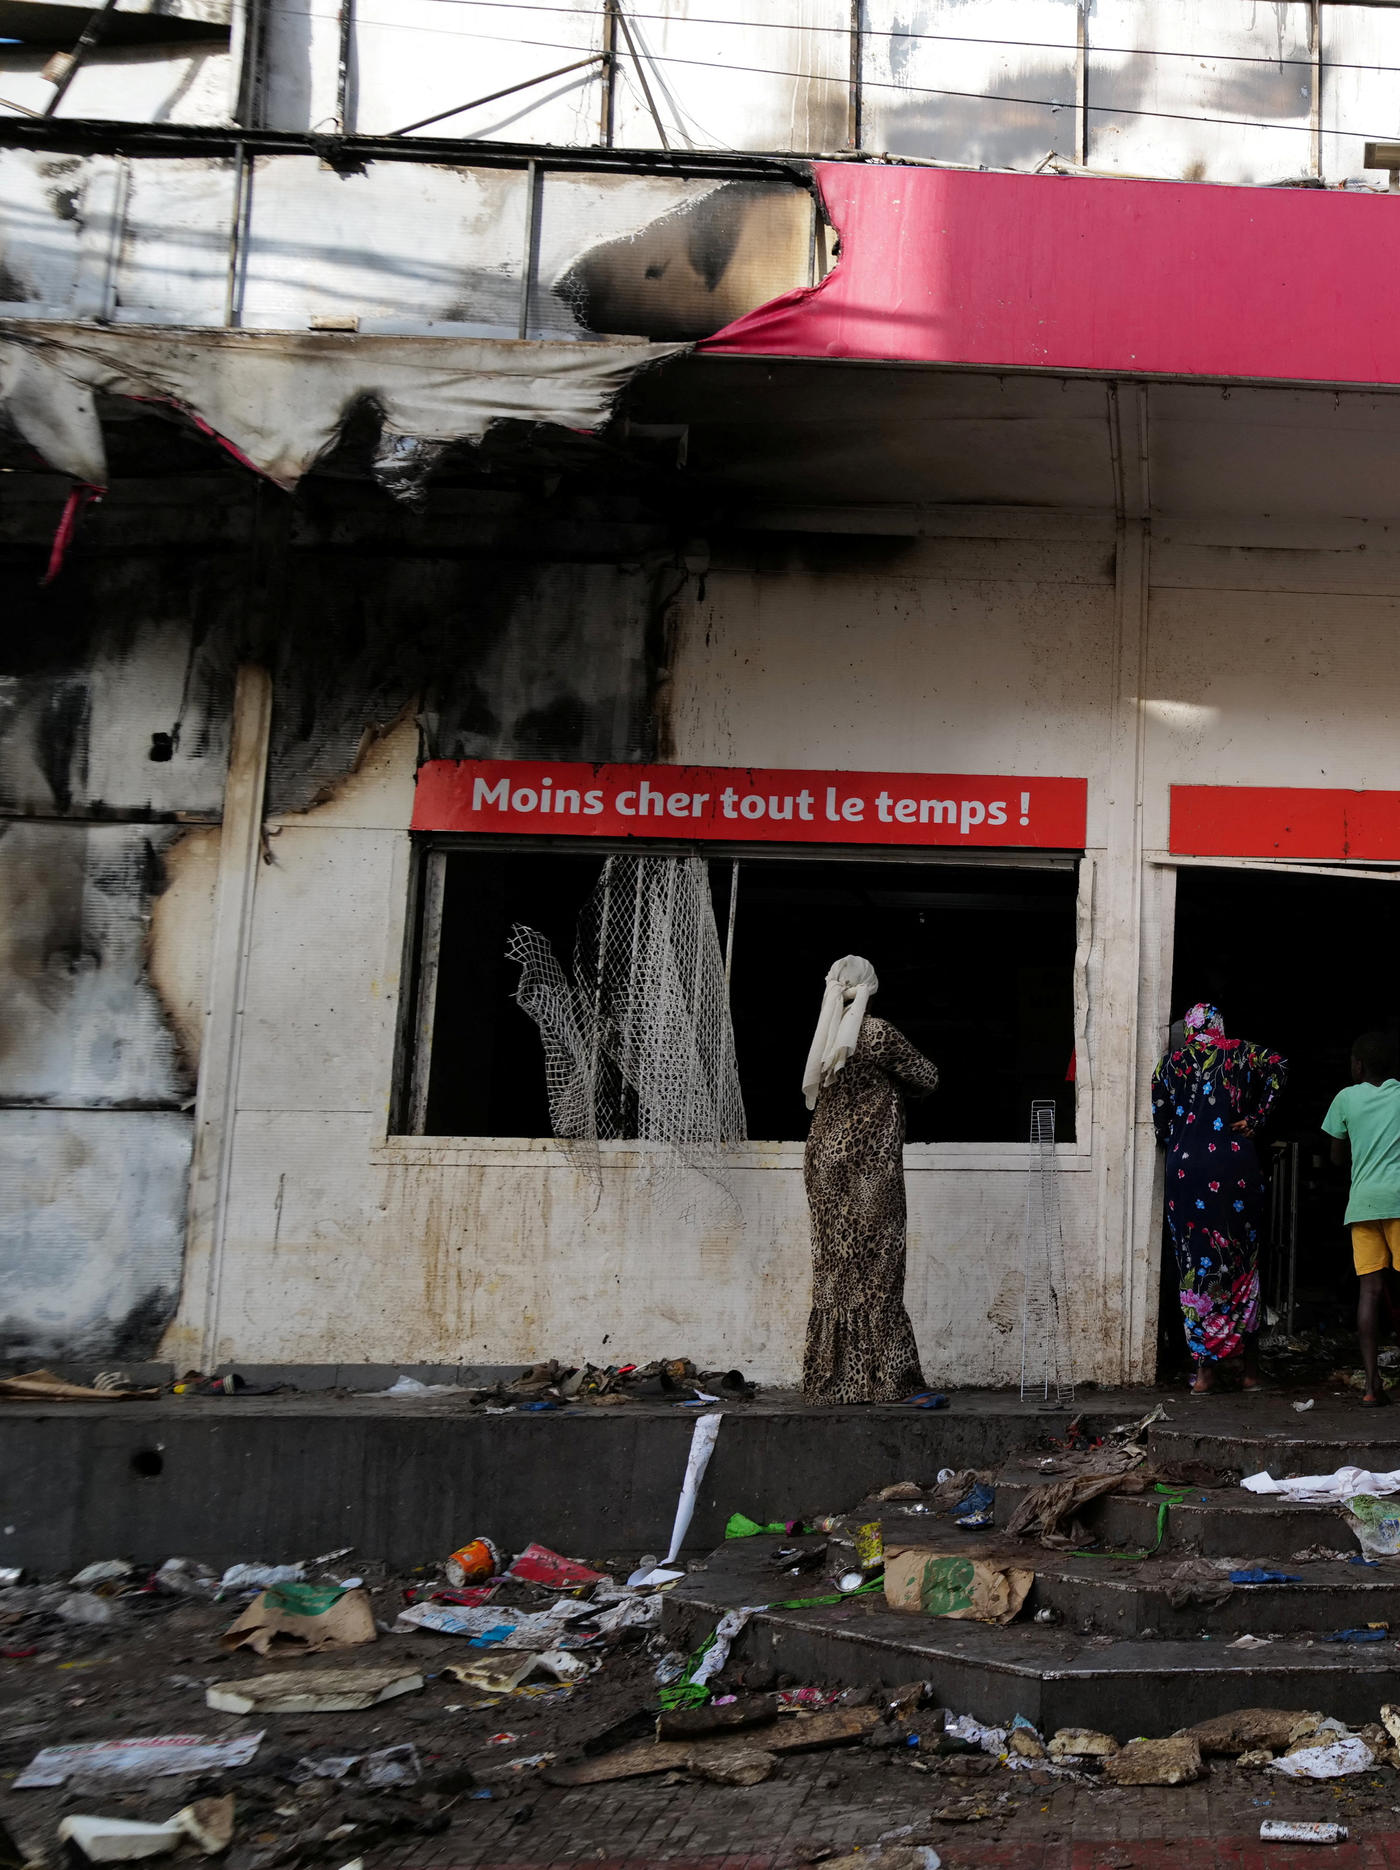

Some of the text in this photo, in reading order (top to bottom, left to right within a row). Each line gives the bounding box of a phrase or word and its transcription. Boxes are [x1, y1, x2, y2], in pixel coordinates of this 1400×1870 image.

[471, 776, 604, 816] Moins
[614, 781, 710, 818] cher
[720, 786, 815, 821] tout
[825, 787, 866, 823] le
[875, 790, 1009, 834] temps
